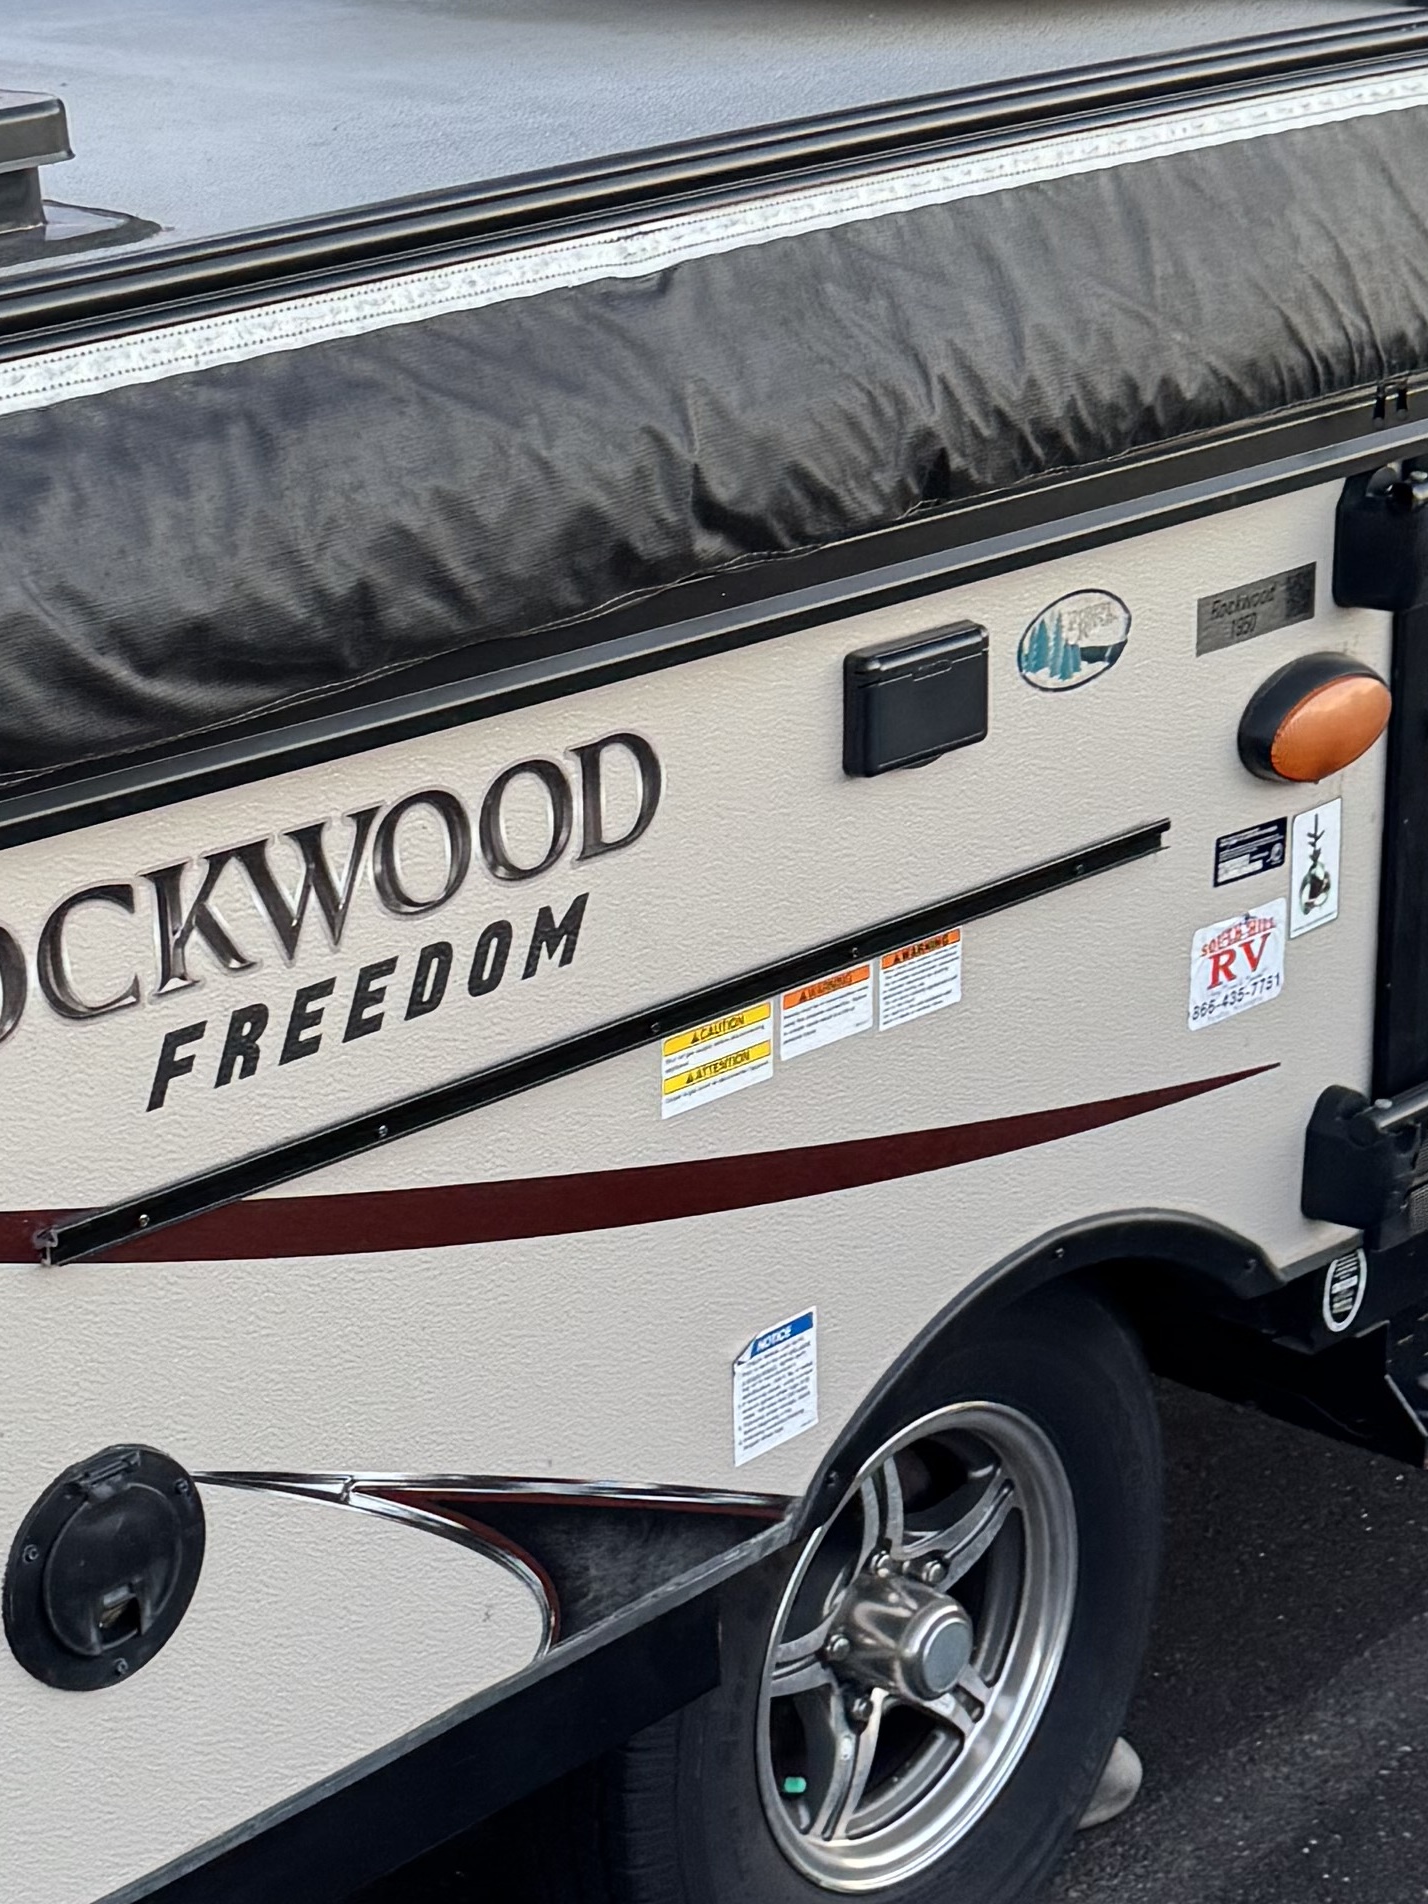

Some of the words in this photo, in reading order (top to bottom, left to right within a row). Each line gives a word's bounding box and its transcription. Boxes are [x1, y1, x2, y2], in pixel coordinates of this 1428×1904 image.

[1207, 932, 1272, 990] RV
[146, 893, 591, 1112] FREEDOM
[700, 1014, 745, 1040] CAUTION
[756, 1325, 793, 1353] NOTICE
